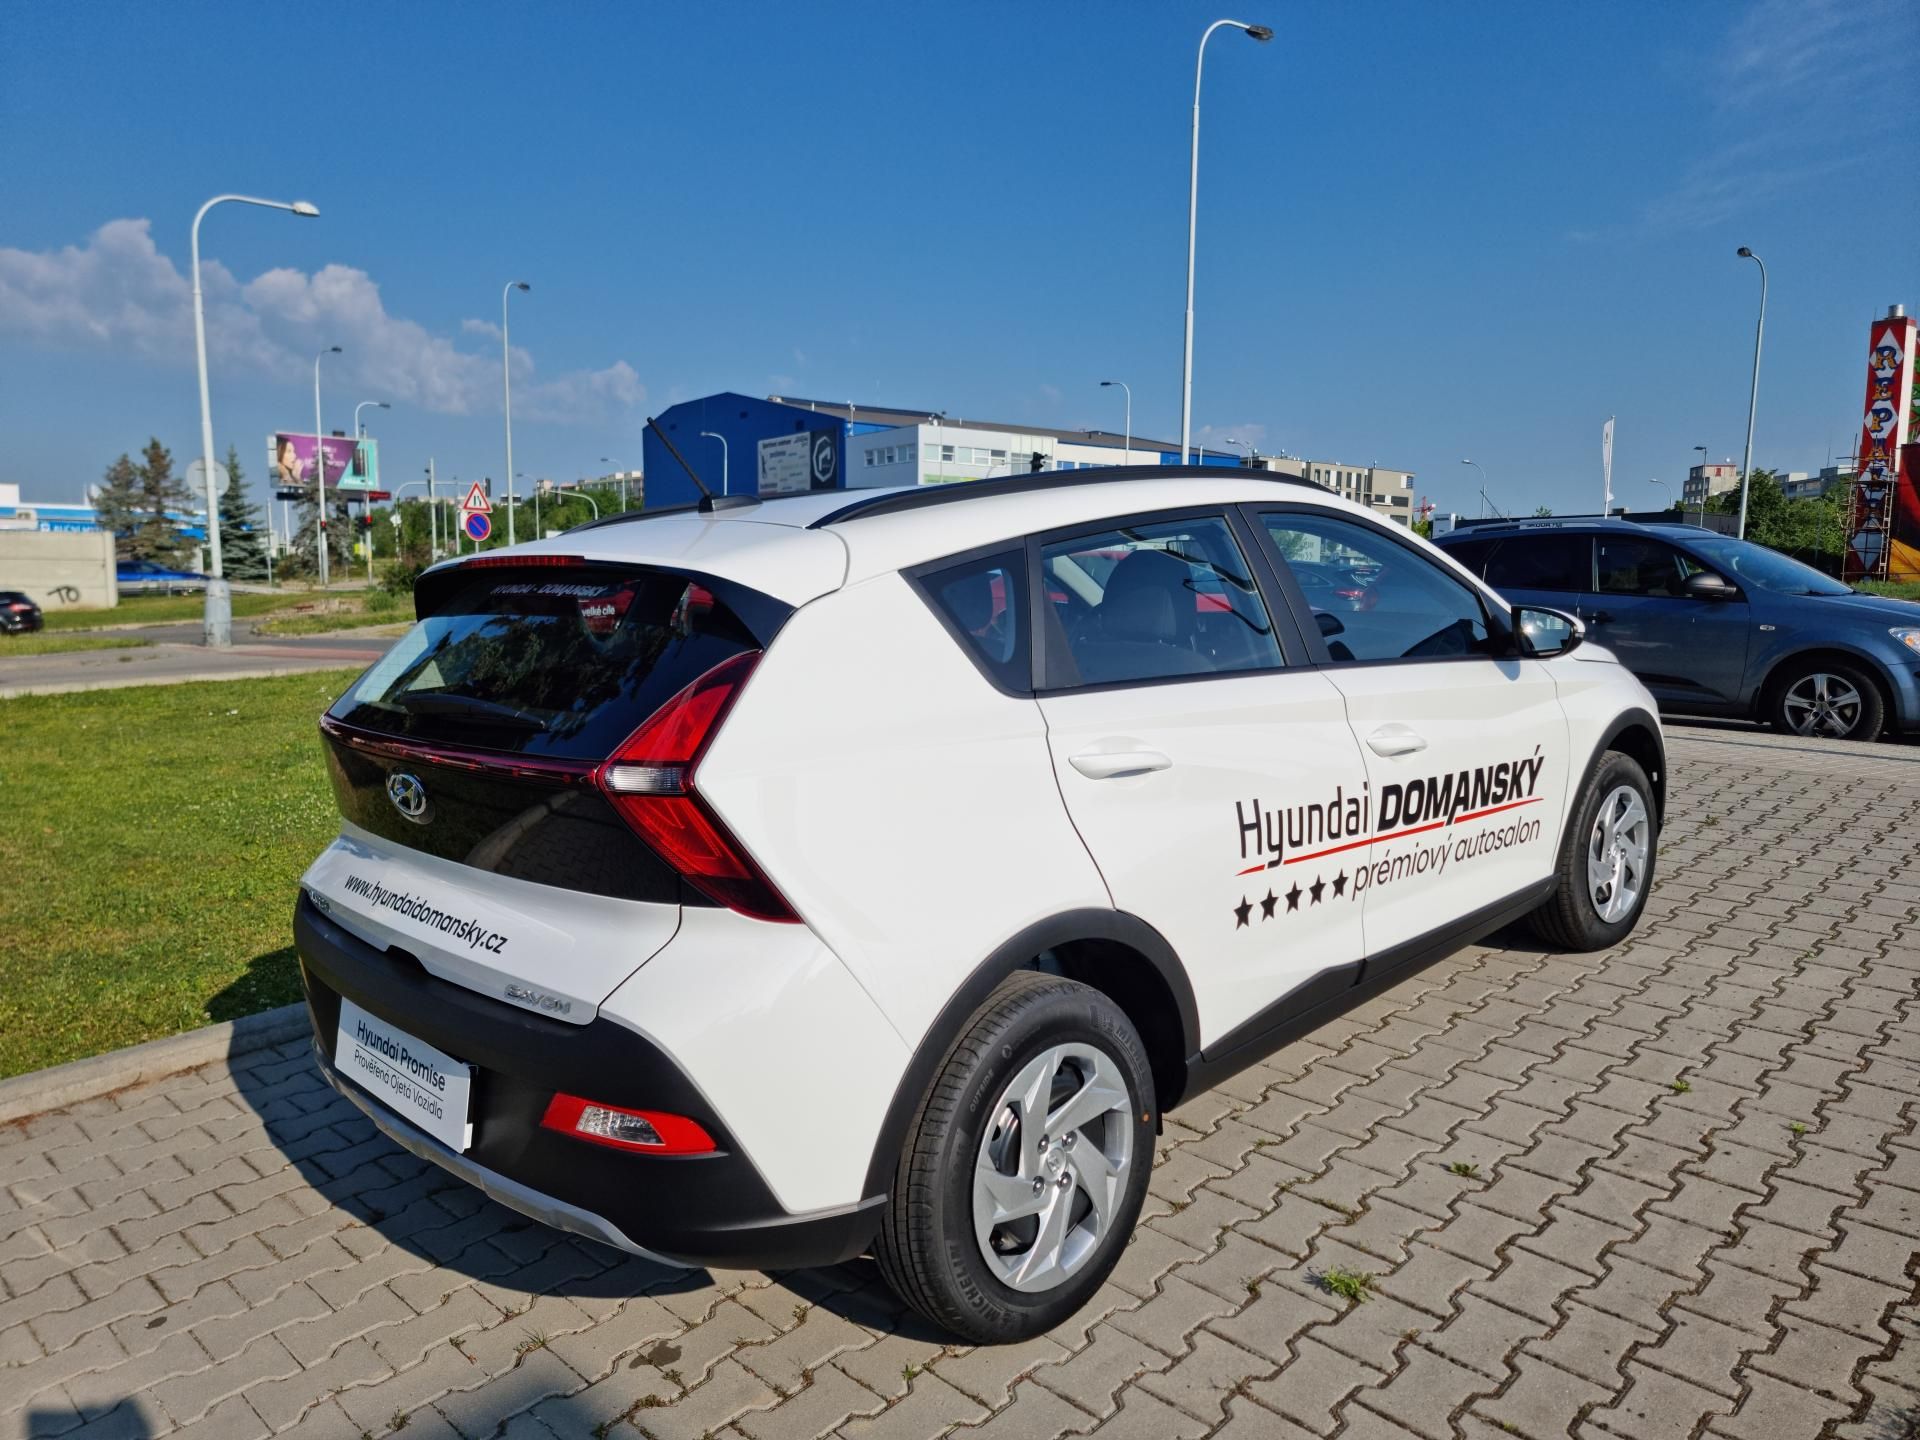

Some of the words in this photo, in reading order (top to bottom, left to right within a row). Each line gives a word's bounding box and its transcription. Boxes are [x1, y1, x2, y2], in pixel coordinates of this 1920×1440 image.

[1235, 781, 1369, 869] Hyundai
[1376, 744, 1545, 826] DOMANSKÝ
[1351, 833, 1454, 902] prémiový
[1454, 815, 1541, 863] autosalon
[343, 873, 509, 955] www.hyundaidomansky.cz
[354, 1049, 391, 1086] Prověřená
[390, 1074, 412, 1100] Ojetá
[413, 1087, 443, 1121] Vozidla
[357, 1019, 400, 1063] Hyundai
[400, 1045, 446, 1092] Promise
